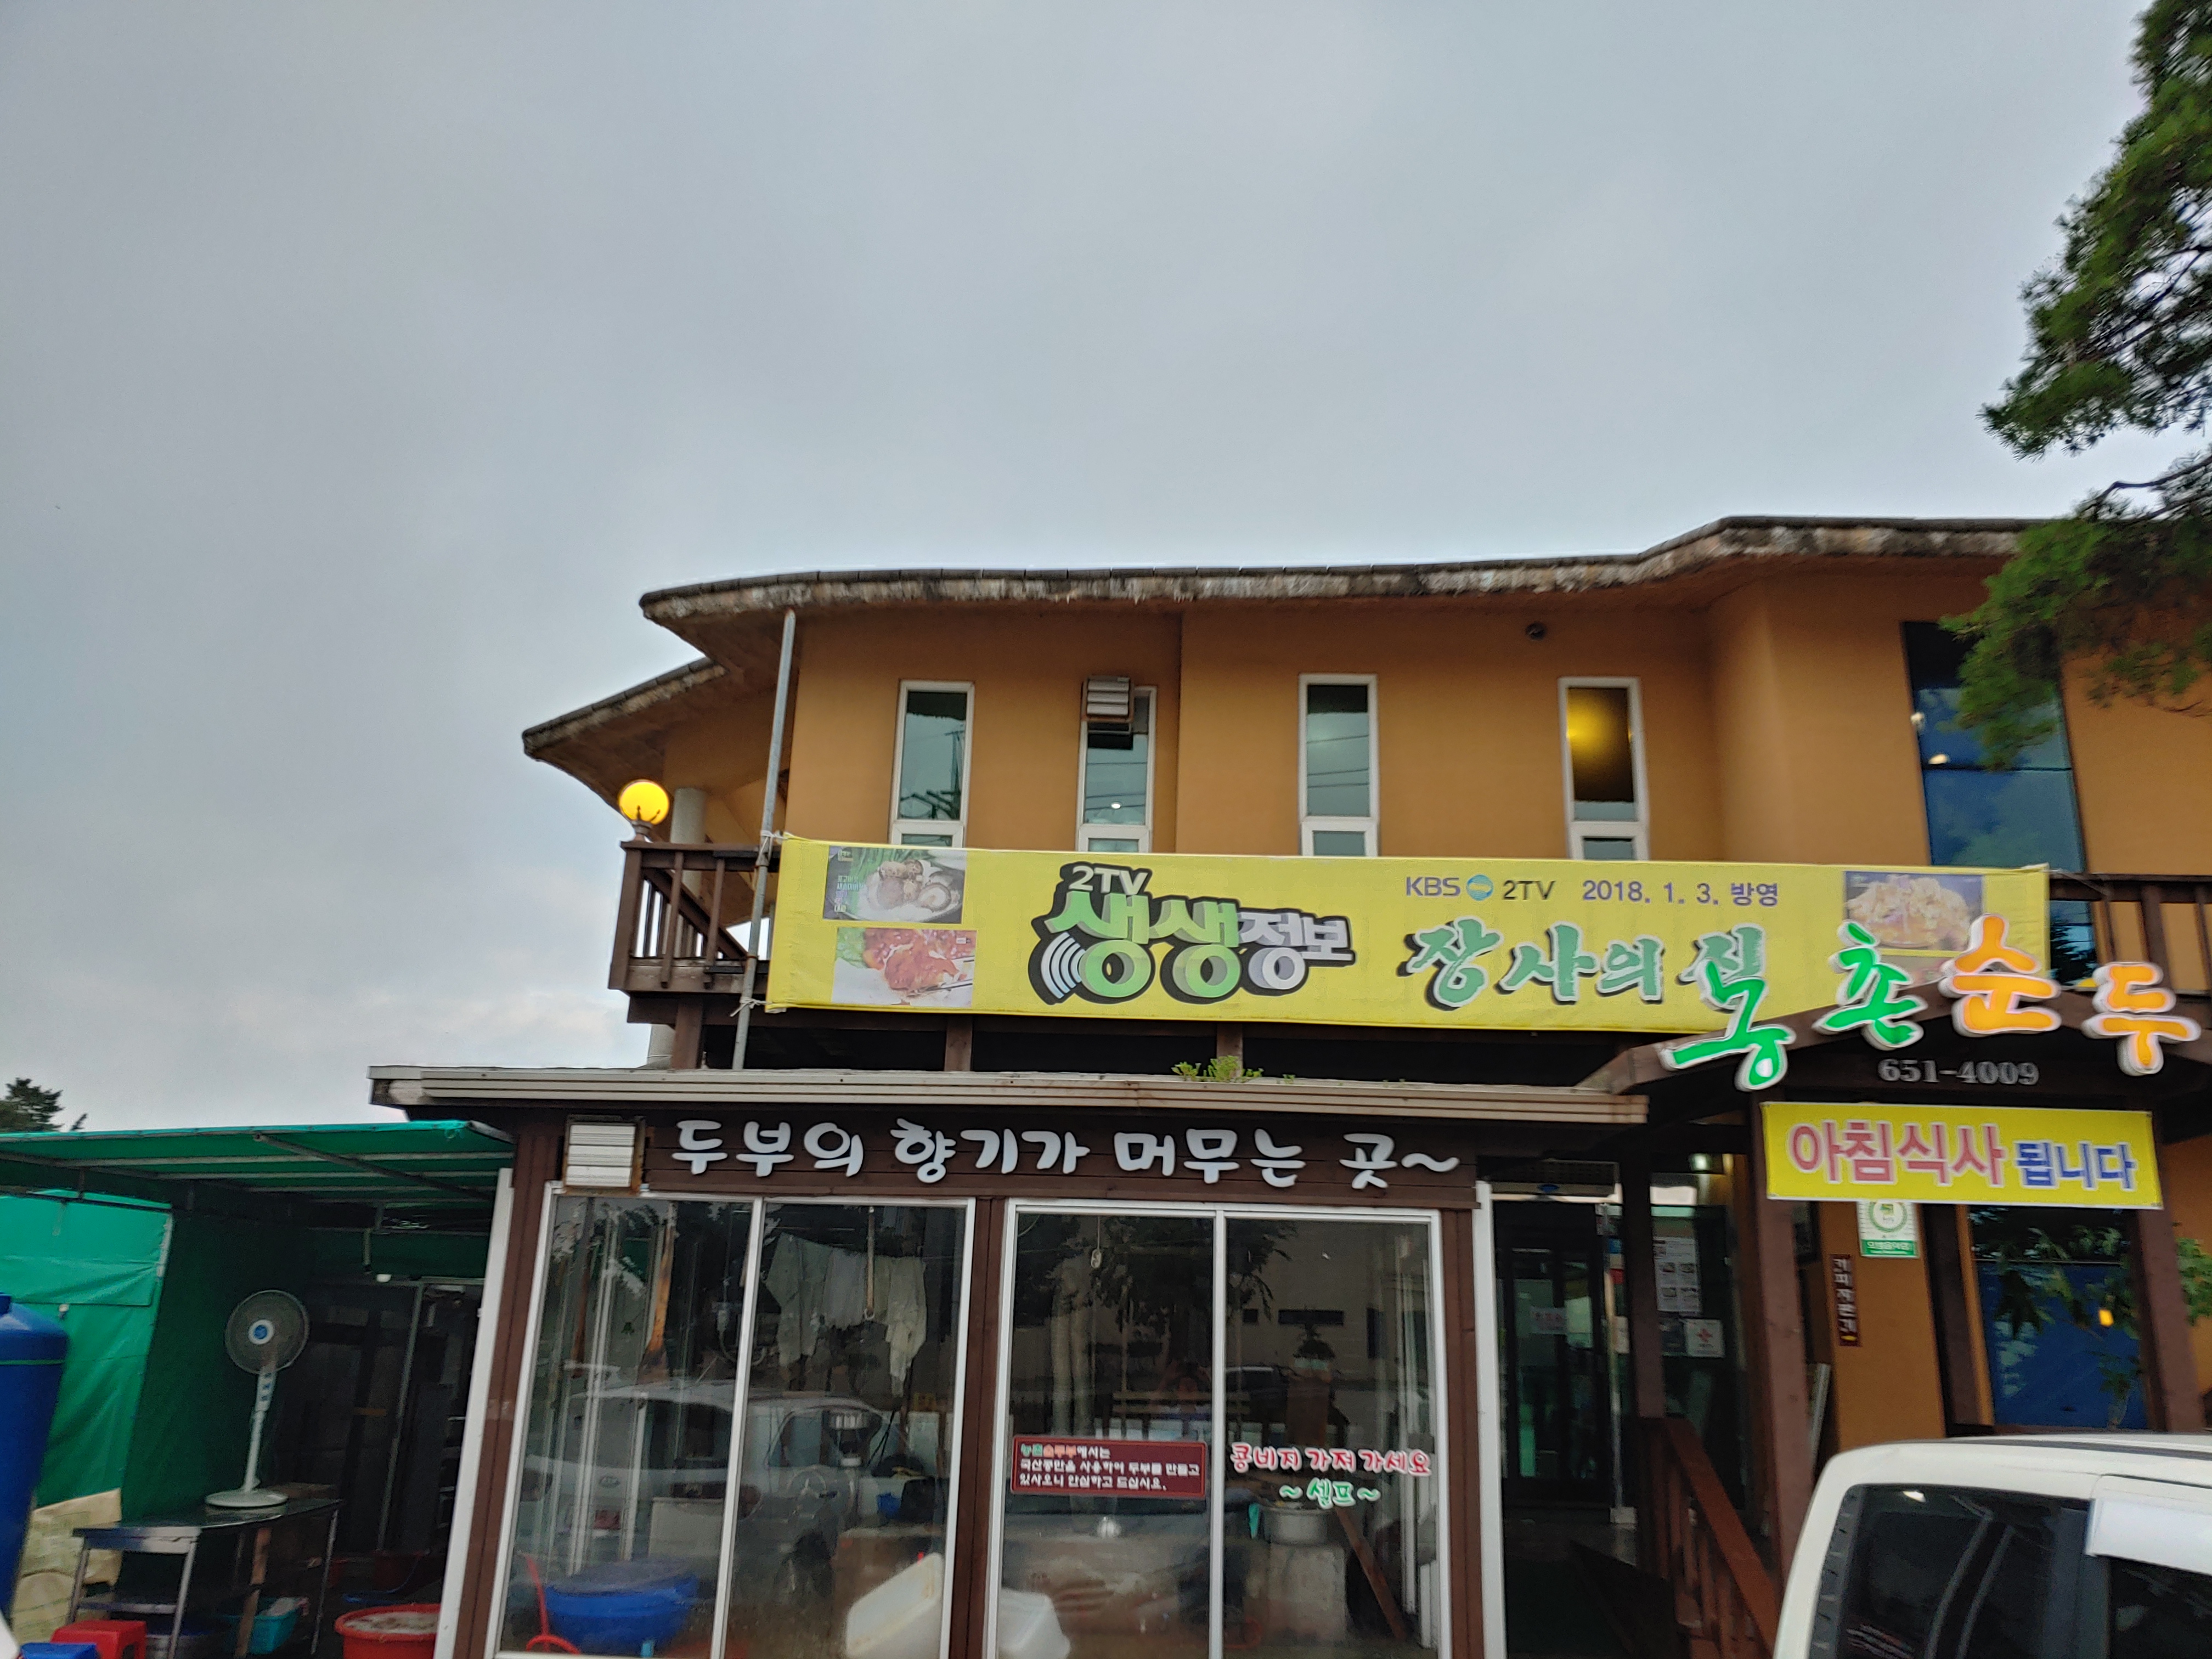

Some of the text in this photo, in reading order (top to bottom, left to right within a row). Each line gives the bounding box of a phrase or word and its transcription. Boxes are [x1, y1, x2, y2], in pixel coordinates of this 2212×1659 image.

[1069, 866, 1148, 895] 2TV
[1406, 876, 1779, 907] KBS 2TV 2018. 1. 3. 방영
[1043, 891, 1353, 998] 생생정보
[1406, 916, 1662, 1007] 장사의
[1877, 1058, 2040, 1086] 651-4009
[672, 1120, 865, 1177] 두부의
[890, 1118, 1091, 1183] 향기가
[1114, 1127, 1307, 1188] 머무는
[1789, 1119, 2136, 1191] 아침식사 됩니다
[1019, 1458, 1200, 1477] 국산콩만을 사용하여 두부를 만들고
[1231, 1442, 1432, 1477] 콩비지 가져 가세요
[1019, 1472, 1064, 1487] 있사오니
[1068, 1475, 1113, 1488] 안심하고
[1306, 1477, 1356, 1510] 셀프
